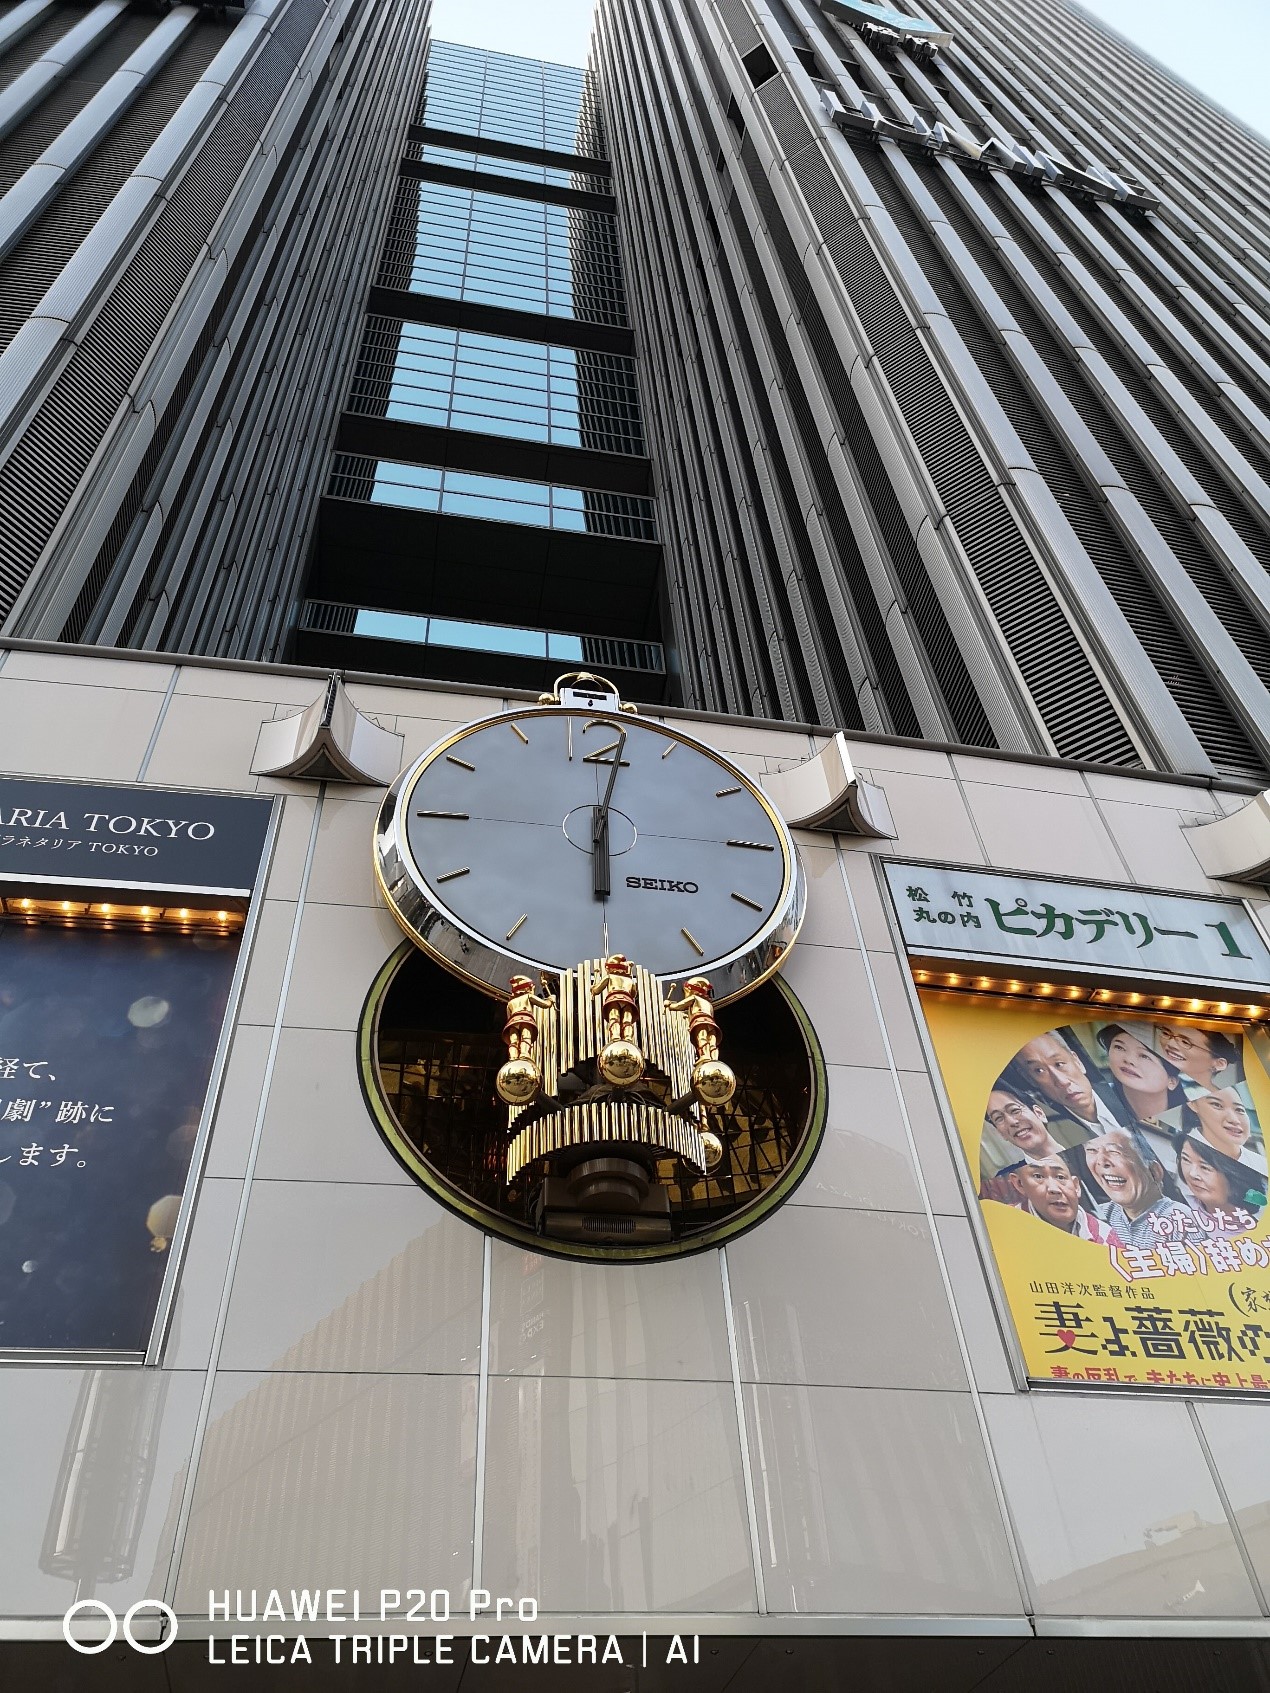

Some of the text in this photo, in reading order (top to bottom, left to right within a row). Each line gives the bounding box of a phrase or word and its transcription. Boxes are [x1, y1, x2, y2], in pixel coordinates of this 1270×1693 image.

[83, 812, 216, 841] TOKYO
[0, 834, 159, 857] ラネタリア TOKYO
[625, 875, 699, 895] SEIKO
[912, 906, 982, 929] 丸の内
[1148, 1206, 1259, 1236] わたしたち
[1029, 1280, 1156, 1300] 山田洋次監督作品
